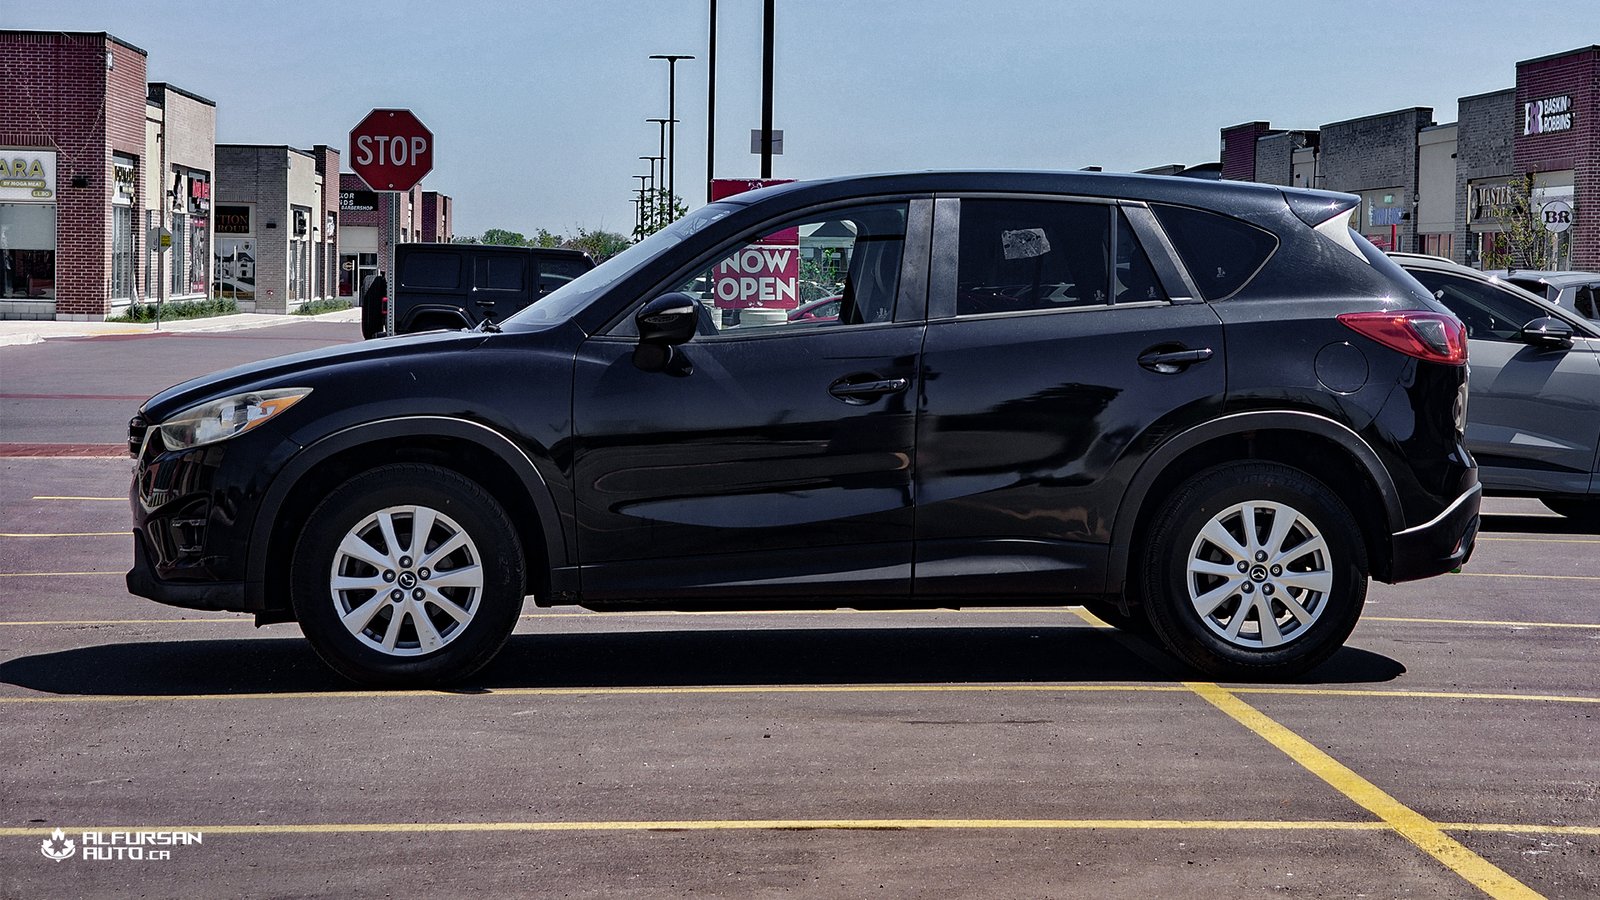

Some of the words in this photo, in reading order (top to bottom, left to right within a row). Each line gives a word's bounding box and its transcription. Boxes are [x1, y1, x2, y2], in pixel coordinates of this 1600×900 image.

[1544, 96, 1568, 115] BASKIN
[1544, 113, 1571, 132] ROBBINS
[357, 136, 427, 166] STOP
[0, 158, 45, 177] ARA
[1479, 186, 1512, 206] MASTER
[1544, 210, 1571, 224] BR
[216, 224, 248, 233] ROUP
[721, 250, 791, 274] NOW
[717, 277, 795, 301] OPEN
